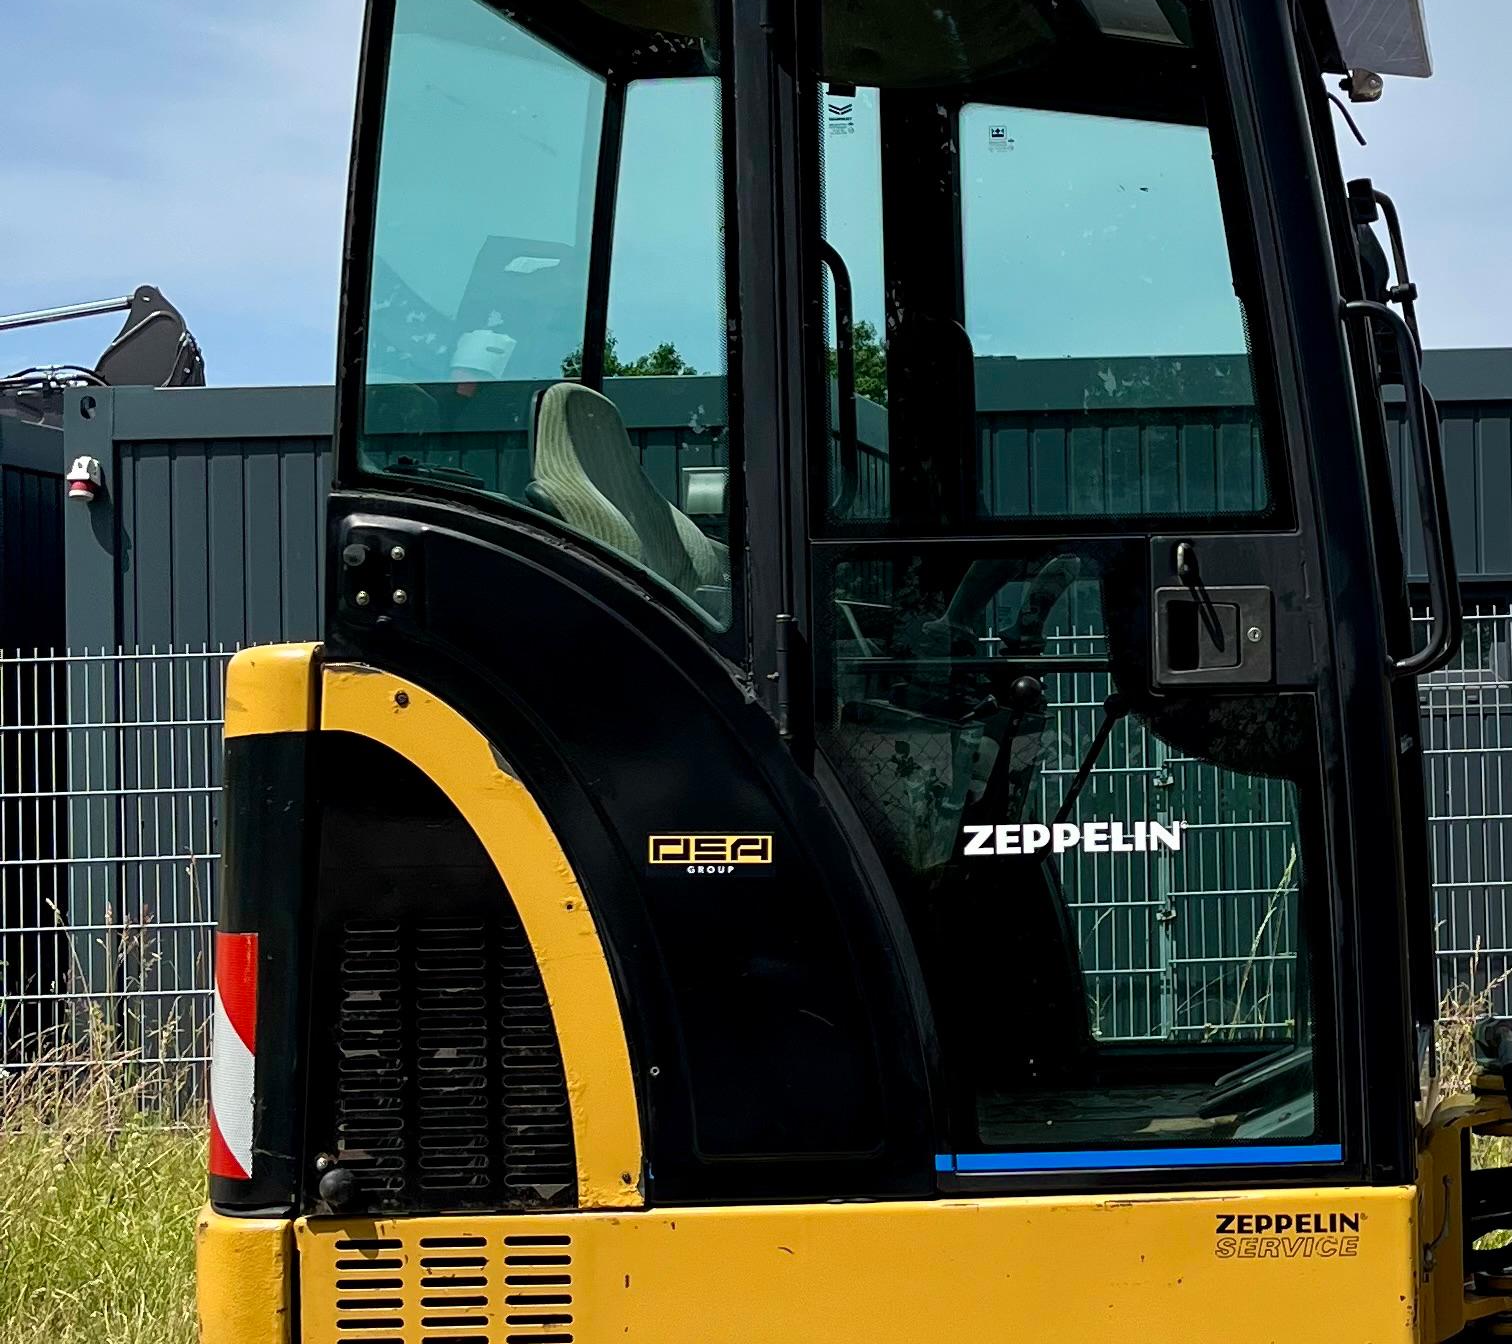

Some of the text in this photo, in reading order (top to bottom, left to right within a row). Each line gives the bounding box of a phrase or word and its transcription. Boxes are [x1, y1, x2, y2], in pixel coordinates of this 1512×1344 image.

[963, 821, 1181, 856] ZEPPELIN
[686, 865, 735, 874] GROUP
[1215, 1212, 1360, 1234] ZEPPELIN
[1215, 1235, 1360, 1258] SERVICE
